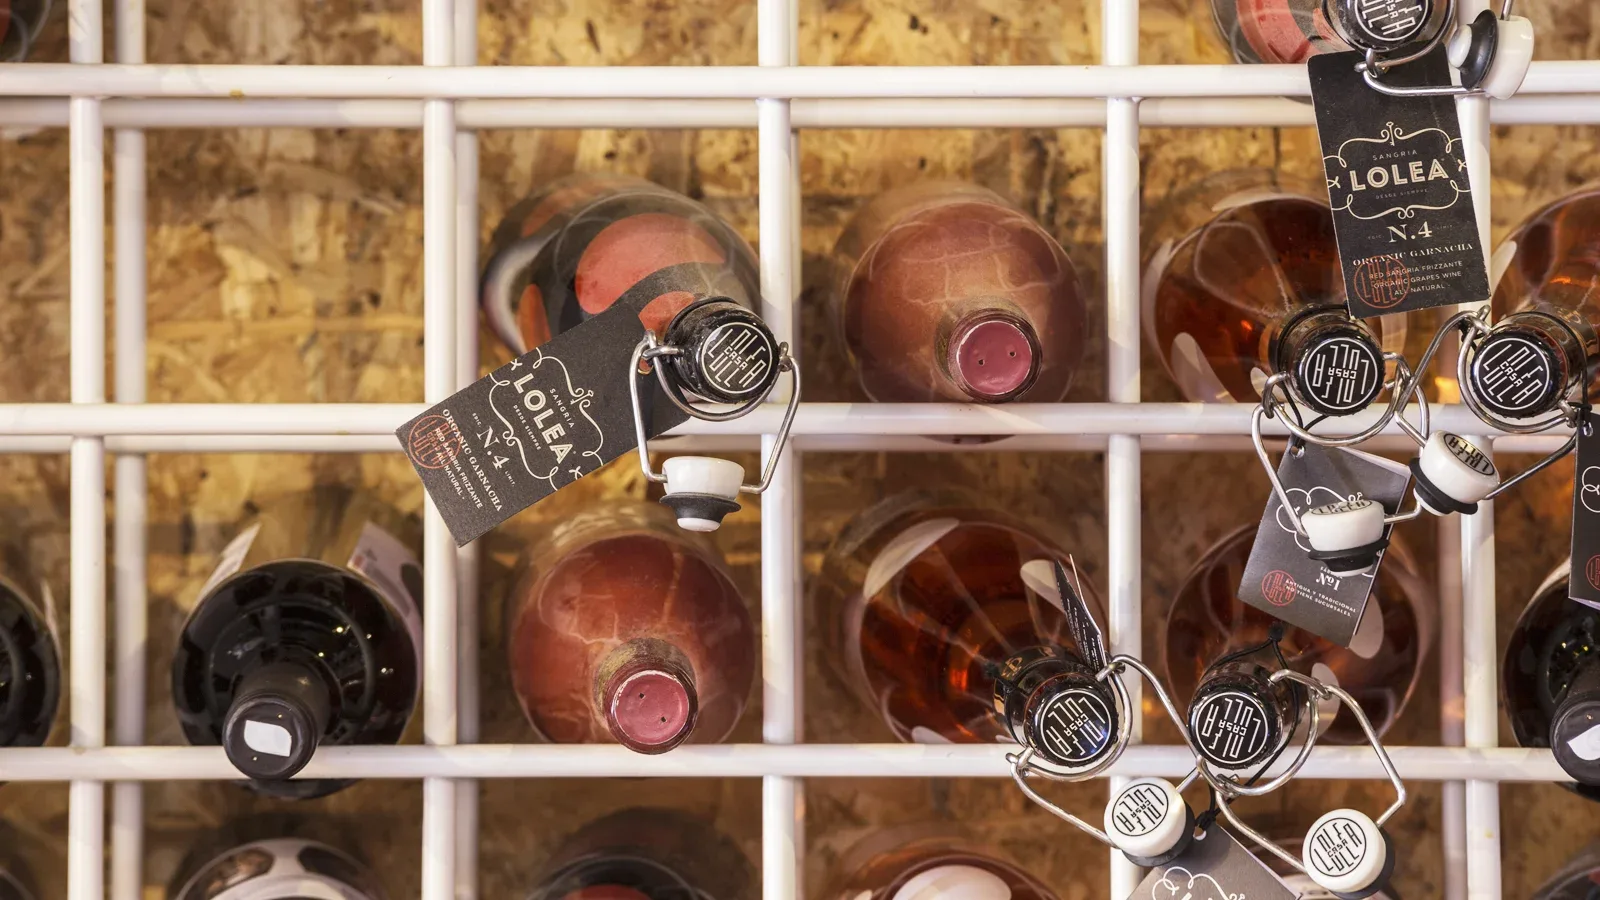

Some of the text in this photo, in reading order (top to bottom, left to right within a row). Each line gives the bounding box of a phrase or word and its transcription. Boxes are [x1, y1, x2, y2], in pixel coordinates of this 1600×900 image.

[1372, 149, 1418, 161] SANGRIA
[1350, 159, 1449, 191] LOLEA
[1386, 221, 1433, 243] N.4
[1353, 242, 1473, 266] ORGANIC GARNACHA
[1386, 266, 1420, 277] SANGRIA
[1422, 260, 1463, 272] FRIZZANTE
[1373, 271, 1462, 289] ORGANIC GRAPES WINE
[1411, 283, 1445, 293] NATURAL
[513, 373, 573, 464] LOLEA
[549, 388, 576, 428] SANGRIA
[513, 404, 542, 451] DESDE SIEMPRE
[442, 409, 504, 512] ORGANIC GARNACHA
[476, 425, 511, 471] N.4
[435, 428, 483, 509] RED SANGRIA FRIZZANTE
[436, 451, 447, 465] ALL
[444, 465, 463, 495] NATURAL
[1285, 579, 1311, 593] ANTIGUA
[1318, 594, 1356, 613] TRADICIONAL
[1297, 590, 1313, 600] TIENE
